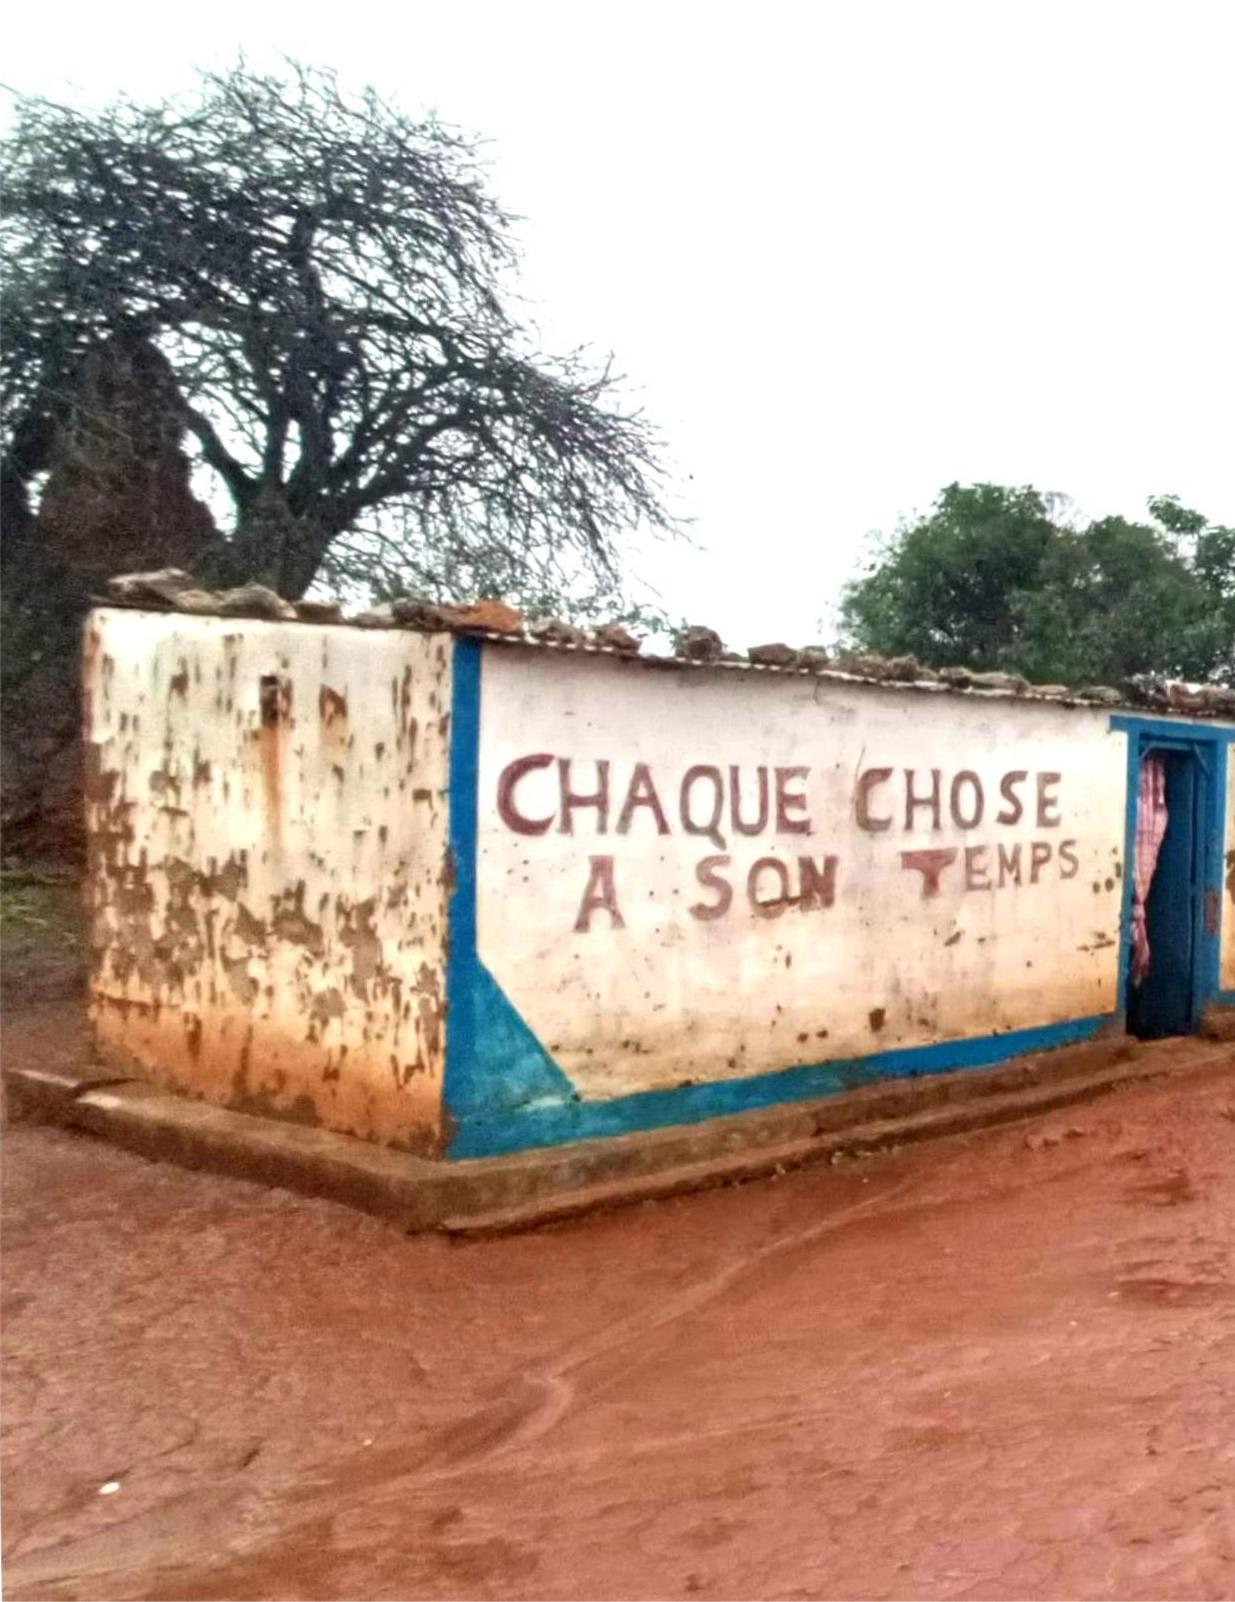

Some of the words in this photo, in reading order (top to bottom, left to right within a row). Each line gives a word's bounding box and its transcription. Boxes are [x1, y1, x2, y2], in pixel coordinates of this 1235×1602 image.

[497, 753, 814, 850] CHAQUE
[854, 766, 1063, 832] CHOSE
[573, 854, 626, 934] A
[689, 854, 840, 921] SON
[900, 839, 1081, 899] TEMPS
